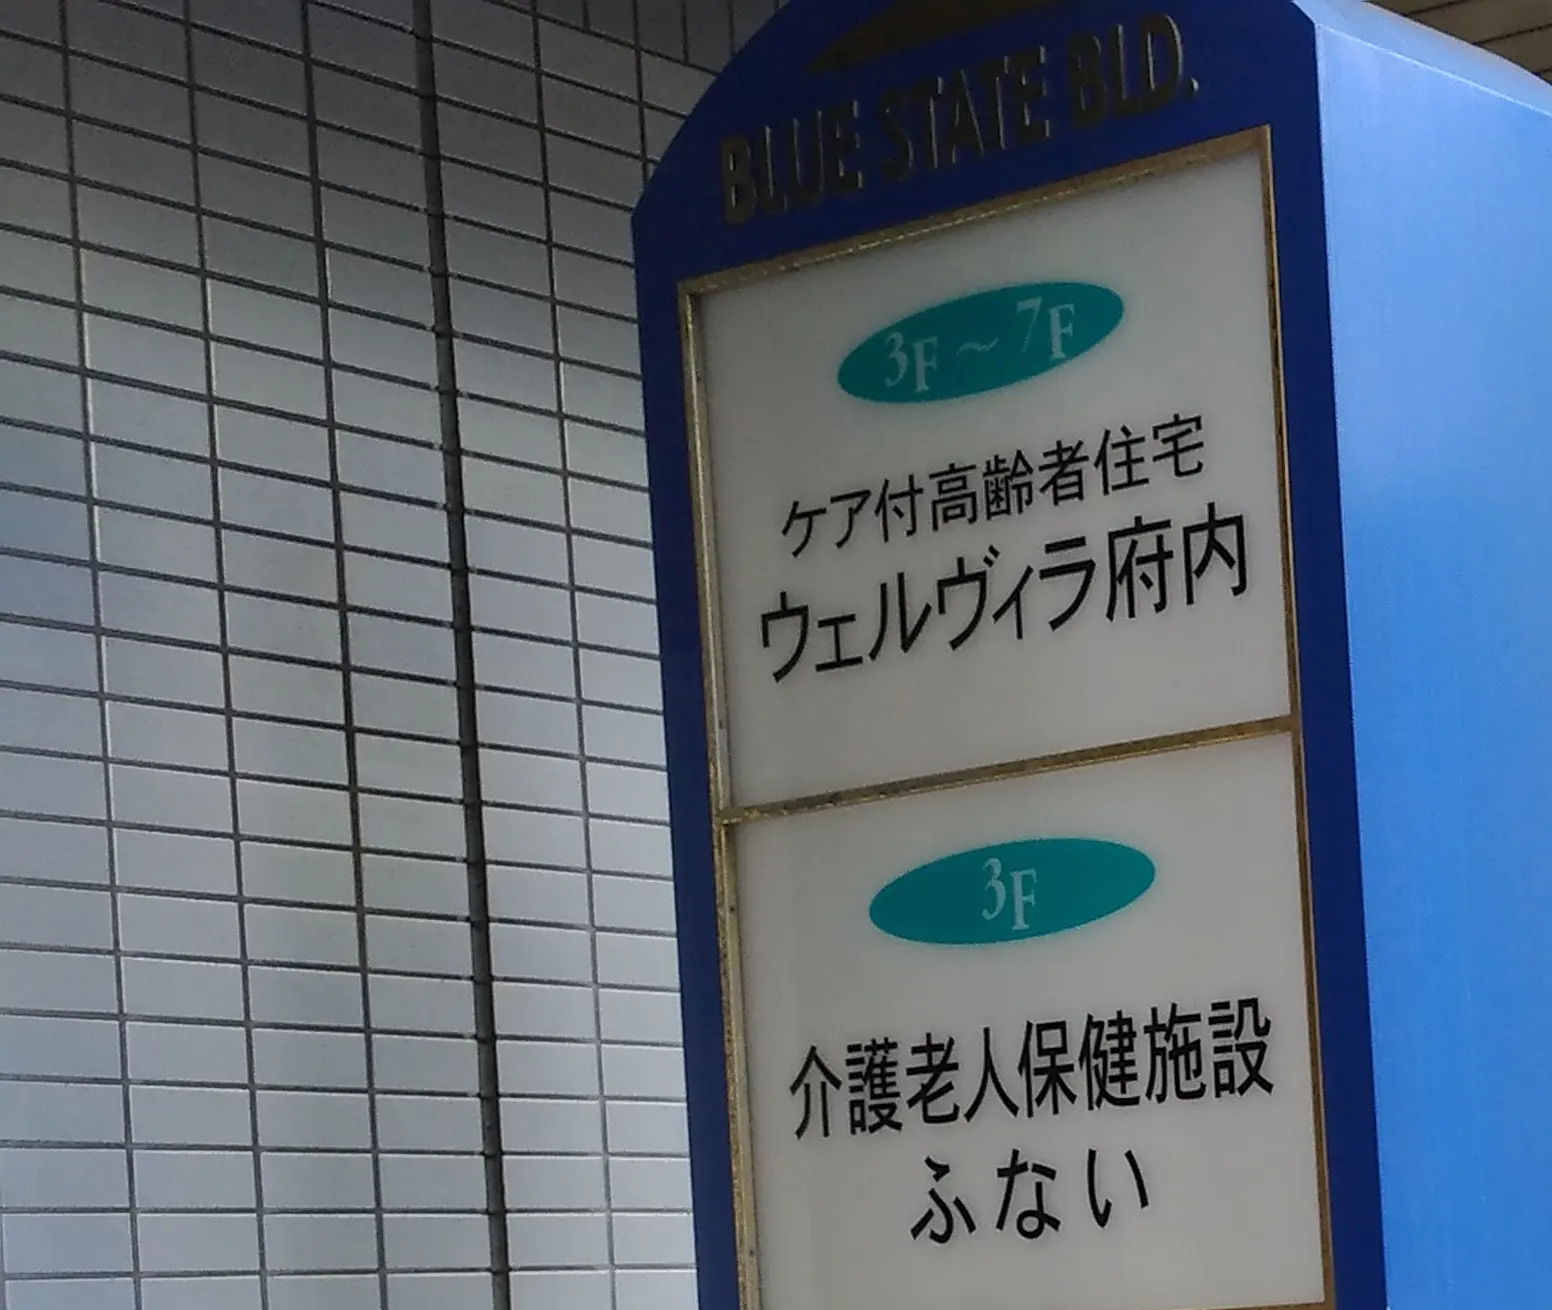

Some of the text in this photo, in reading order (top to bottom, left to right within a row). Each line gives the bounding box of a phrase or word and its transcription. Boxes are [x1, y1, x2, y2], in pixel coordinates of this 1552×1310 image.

[720, 13, 1200, 226] BLUE STATE BLD.
[779, 412, 1206, 558] ケア付高齢者住宅
[760, 504, 1247, 683] ウェルヴィラ府内
[981, 858, 1036, 930] 3F
[789, 998, 1273, 1139] 介護老人保健施設
[910, 1148, 1150, 1244] ふない
